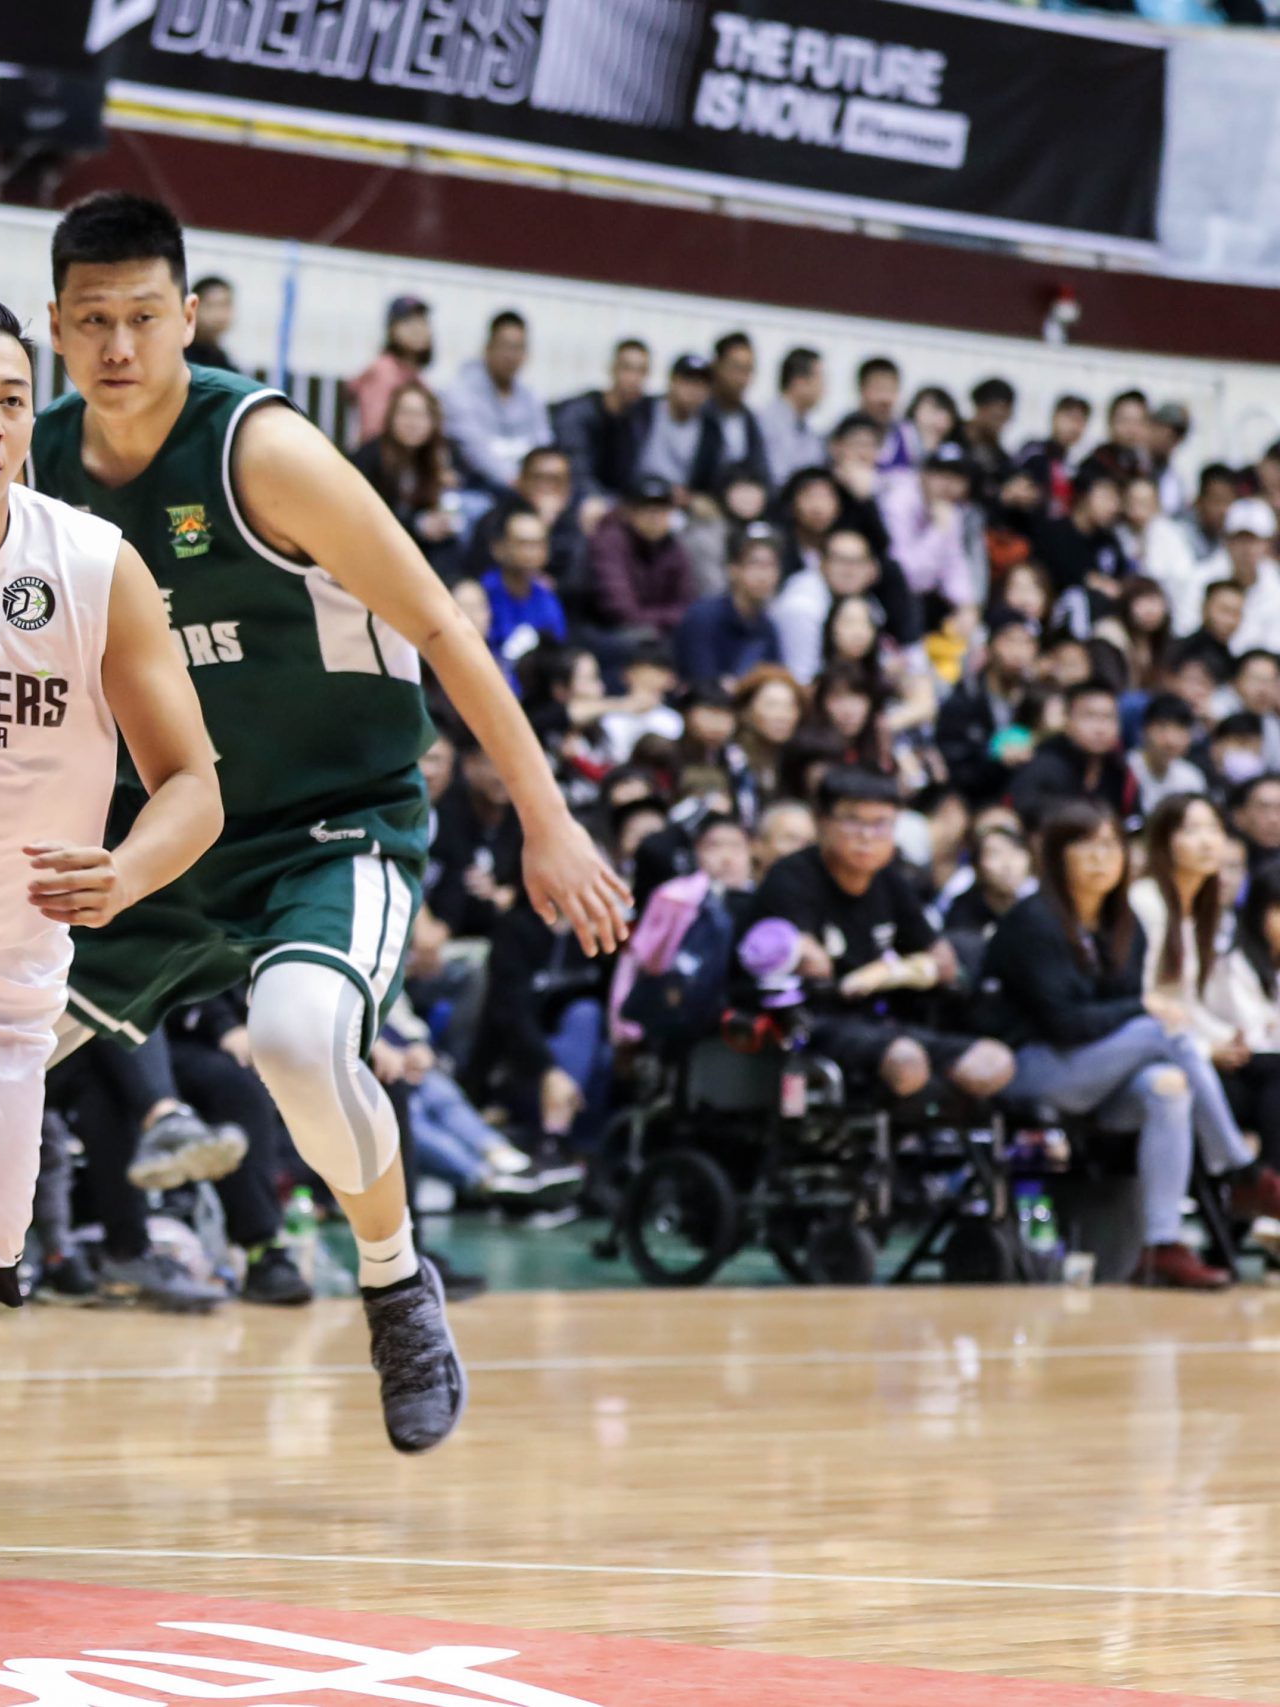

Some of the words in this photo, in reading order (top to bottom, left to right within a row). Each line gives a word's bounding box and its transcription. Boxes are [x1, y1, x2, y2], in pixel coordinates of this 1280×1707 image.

[712, 11, 791, 79] THE
[790, 26, 947, 106] FUTURE
[694, 69, 742, 131] IS
